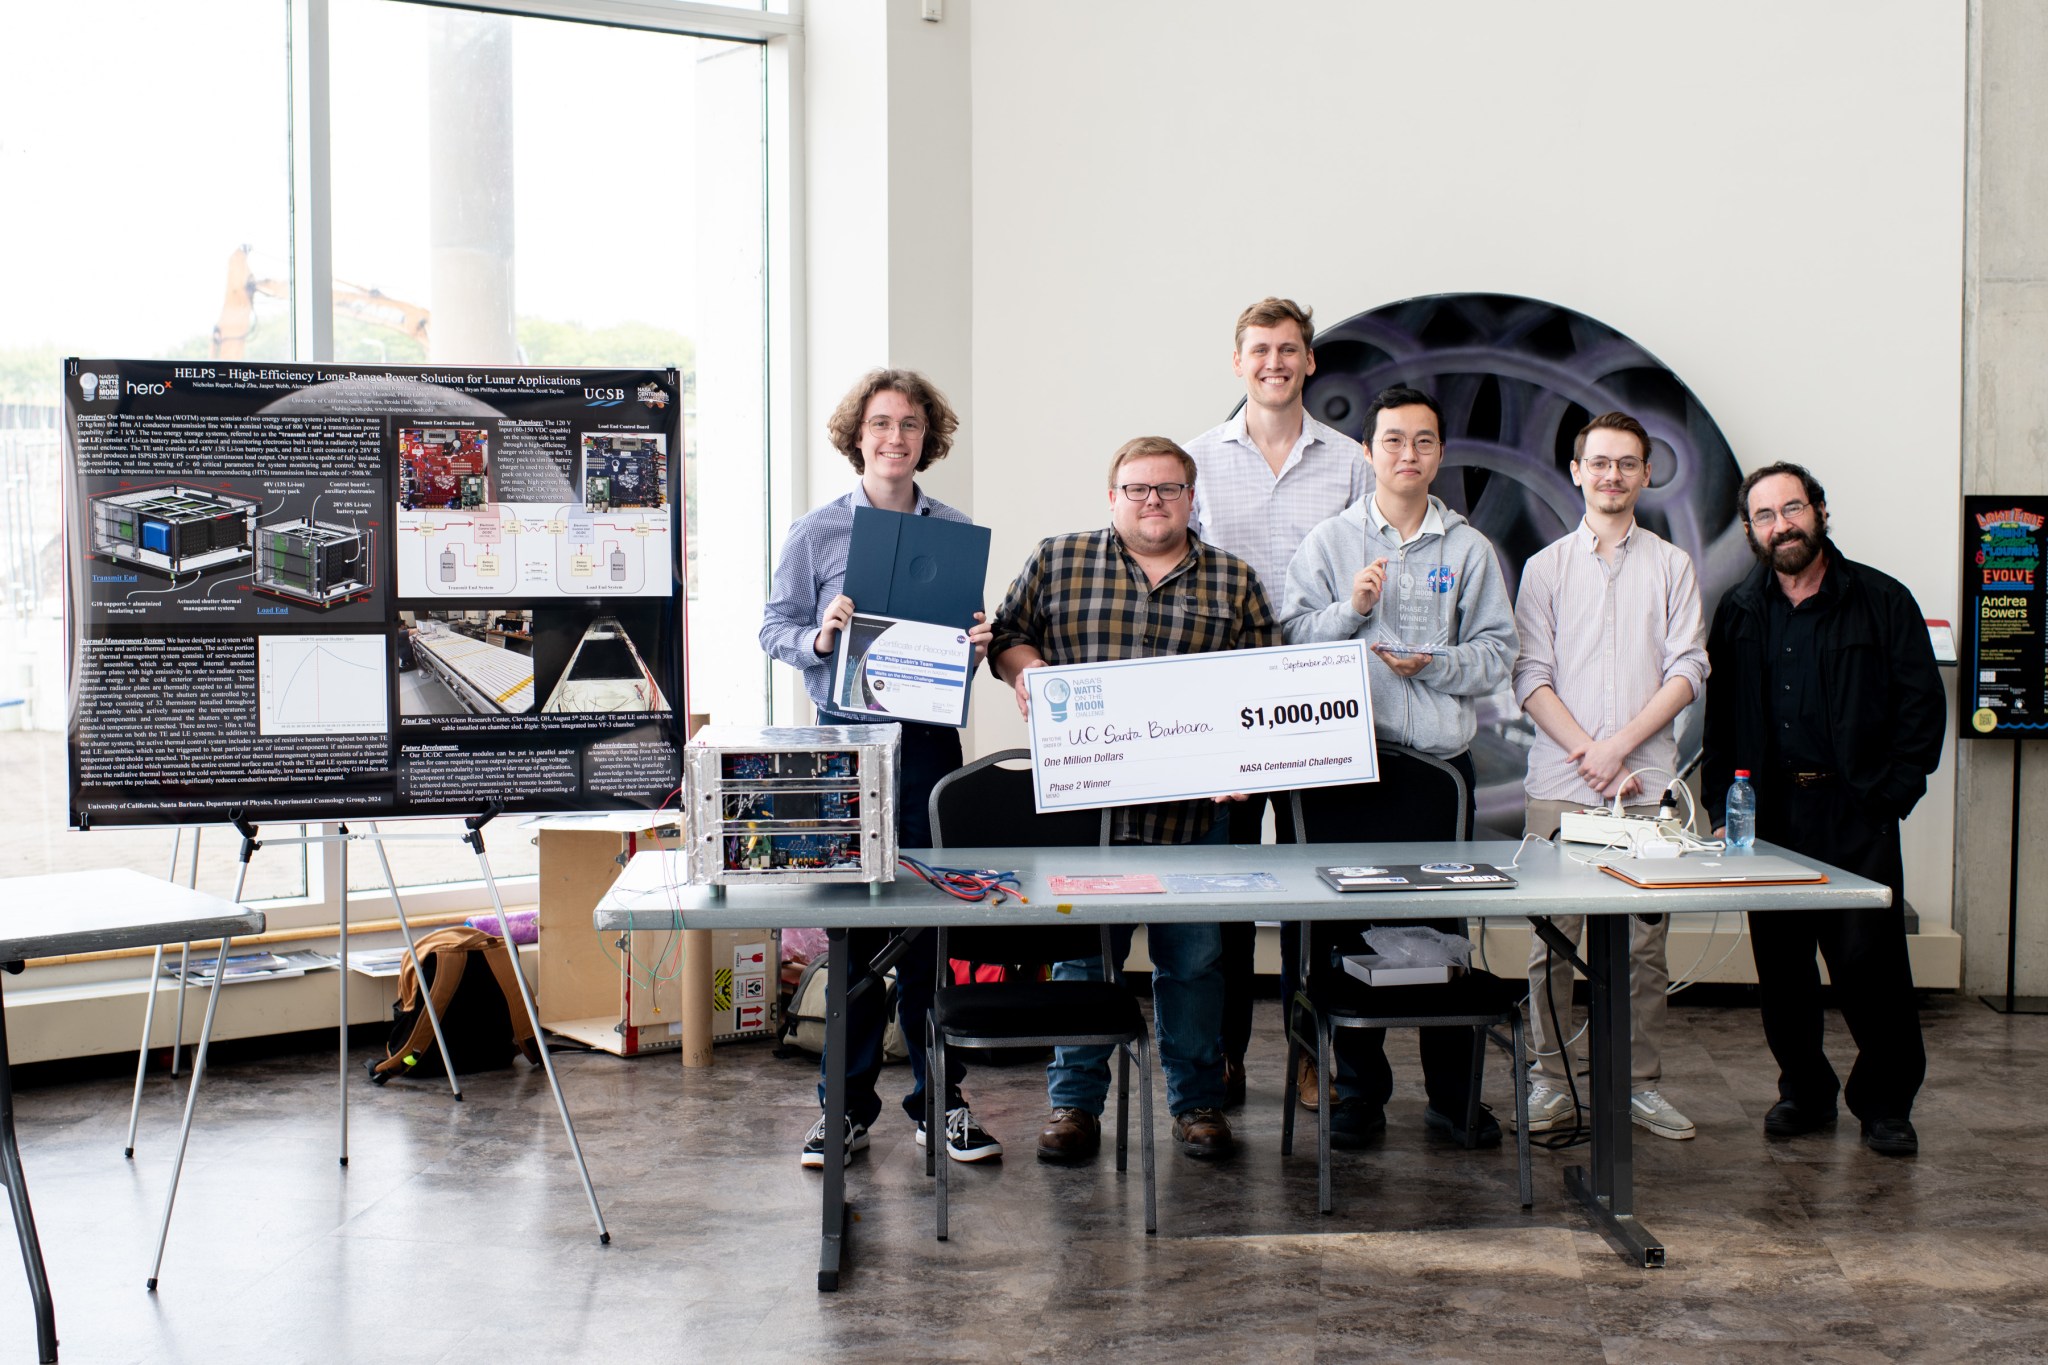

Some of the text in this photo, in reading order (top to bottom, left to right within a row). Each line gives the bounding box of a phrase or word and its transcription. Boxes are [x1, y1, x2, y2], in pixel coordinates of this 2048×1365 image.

[175, 368, 215, 378] HELPS
[229, 369, 314, 382] High-Efficiency
[317, 371, 382, 384] Long-Range
[385, 373, 418, 383] Power
[421, 374, 464, 384] Solution
[467, 374, 482, 384] for
[485, 375, 515, 384] Lunar
[517, 375, 581, 386] Applications
[584, 388, 625, 400] UCSB
[1976, 507, 2044, 528] LAKE ERIE
[1983, 569, 2034, 584] EVOLVE
[1982, 595, 2027, 606] Andrea
[1400, 604, 1421, 612] PHASE
[1982, 608, 2027, 618] Bowers
[1400, 613, 1427, 622] WINNER
[878, 638, 913, 650] Certificate
[923, 645, 964, 656] Recognition
[1282, 657, 1320, 672] September
[1336, 654, 1356, 664] 2024
[1073, 677, 1102, 685] NASA'S
[1074, 685, 1102, 694] WATTS
[1075, 700, 1104, 711] MOON
[1240, 699, 1359, 730] $1,000,000
[1069, 720, 1213, 745] UC Santa Barbara
[1044, 752, 1124, 767] One Million Dollars
[1240, 756, 1352, 773] NASA Centennial Challenges
[1050, 780, 1111, 792] Phase 2 Winner
